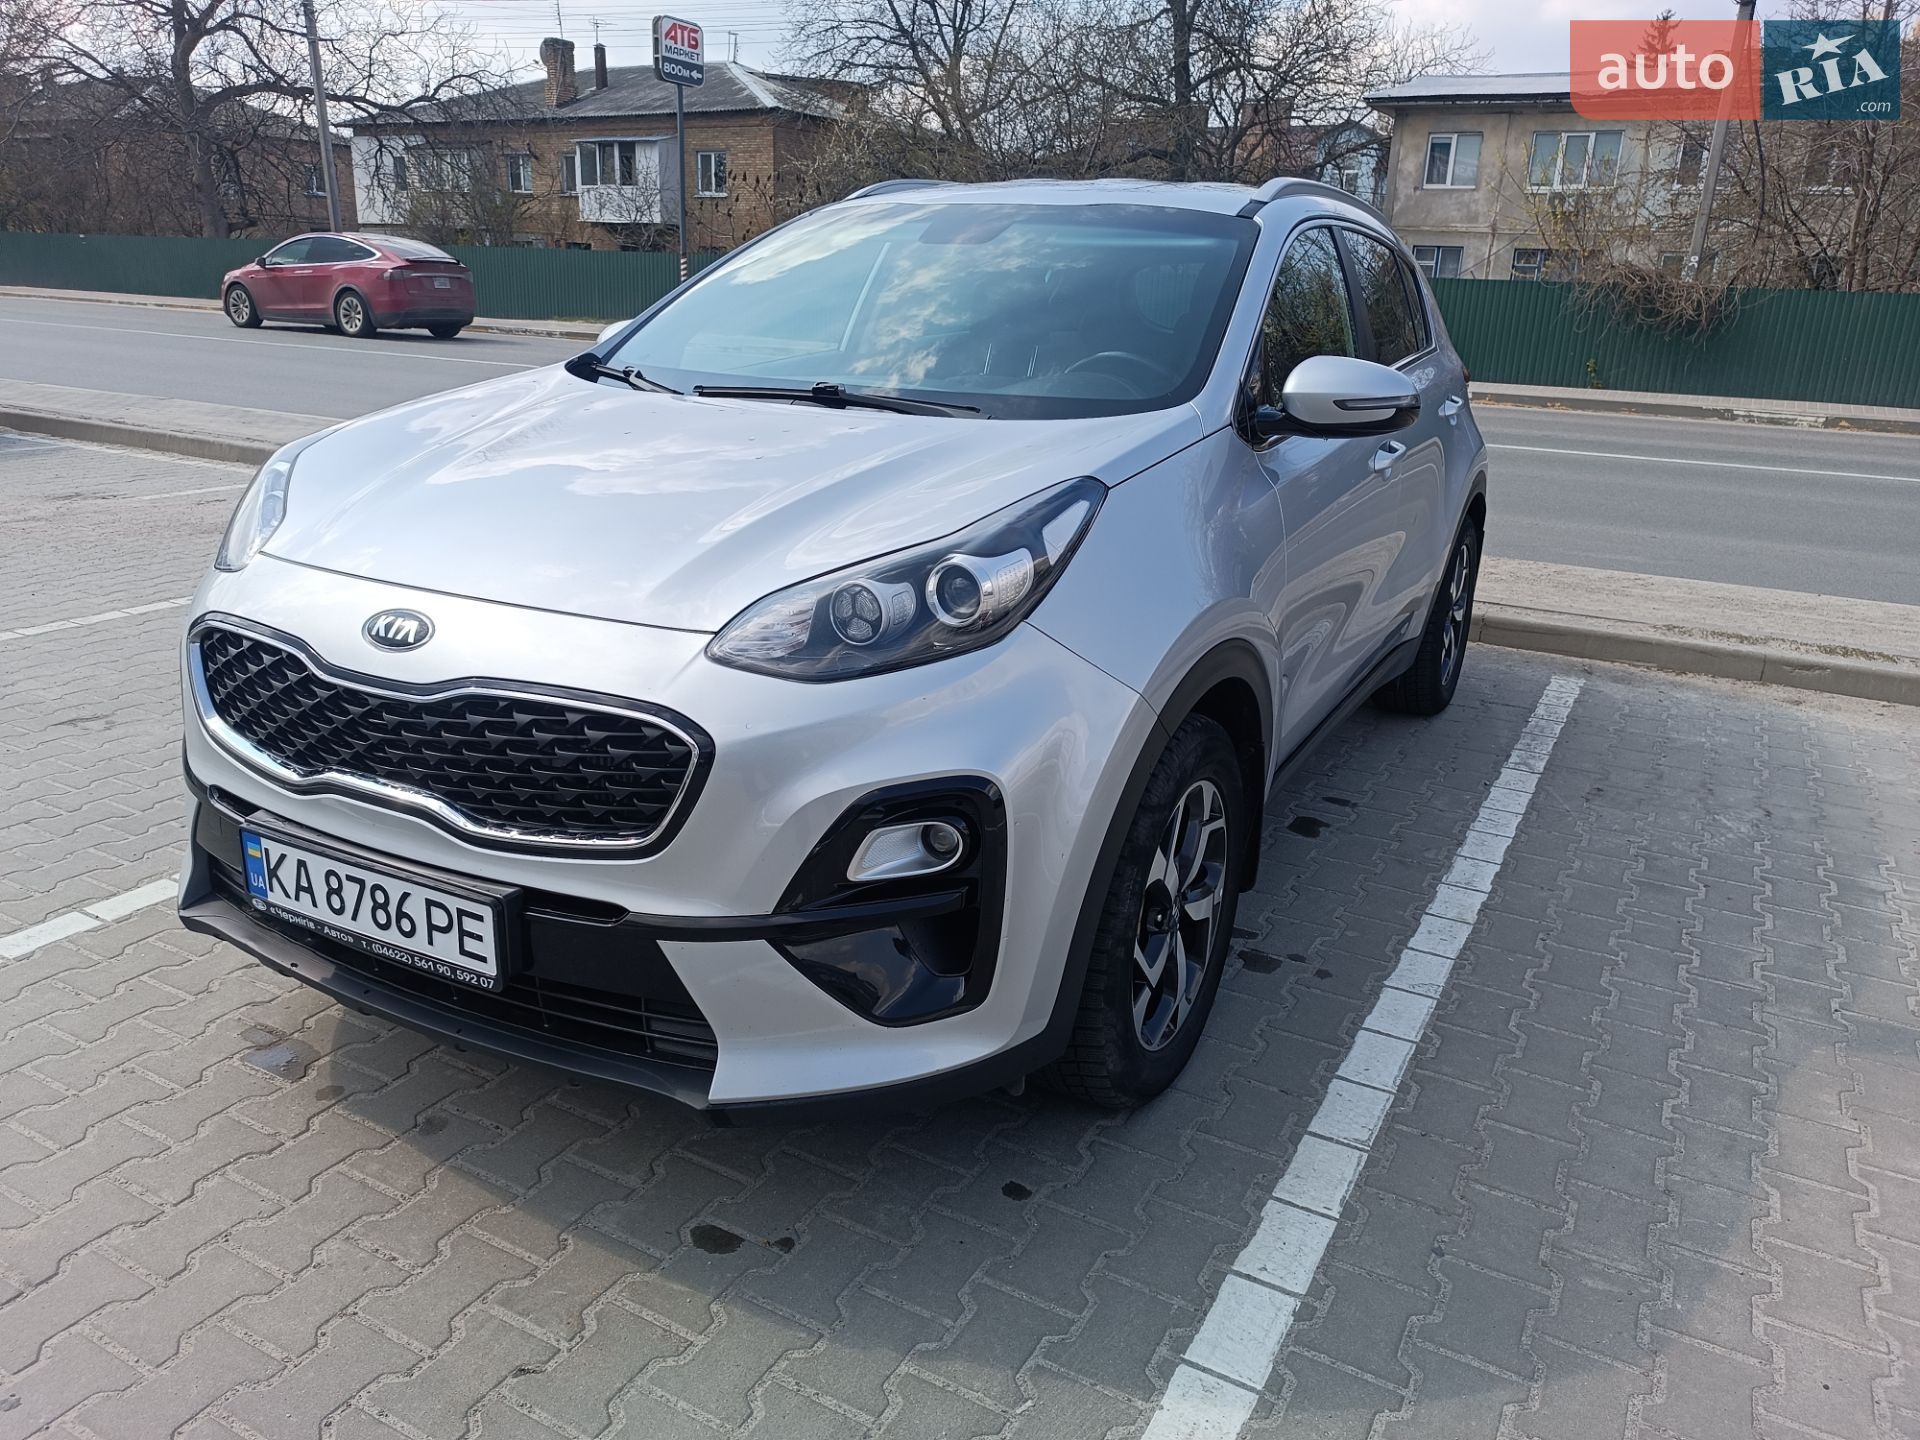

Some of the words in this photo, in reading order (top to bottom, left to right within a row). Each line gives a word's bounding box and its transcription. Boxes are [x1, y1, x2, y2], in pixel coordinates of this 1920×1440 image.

[371, 615, 420, 643] KIA
[250, 871, 266, 891] UA
[372, 943, 412, 965] (04622)
[414, 956, 434, 971] 561
[456, 970, 479, 985] 592
[480, 978, 494, 989] 07
